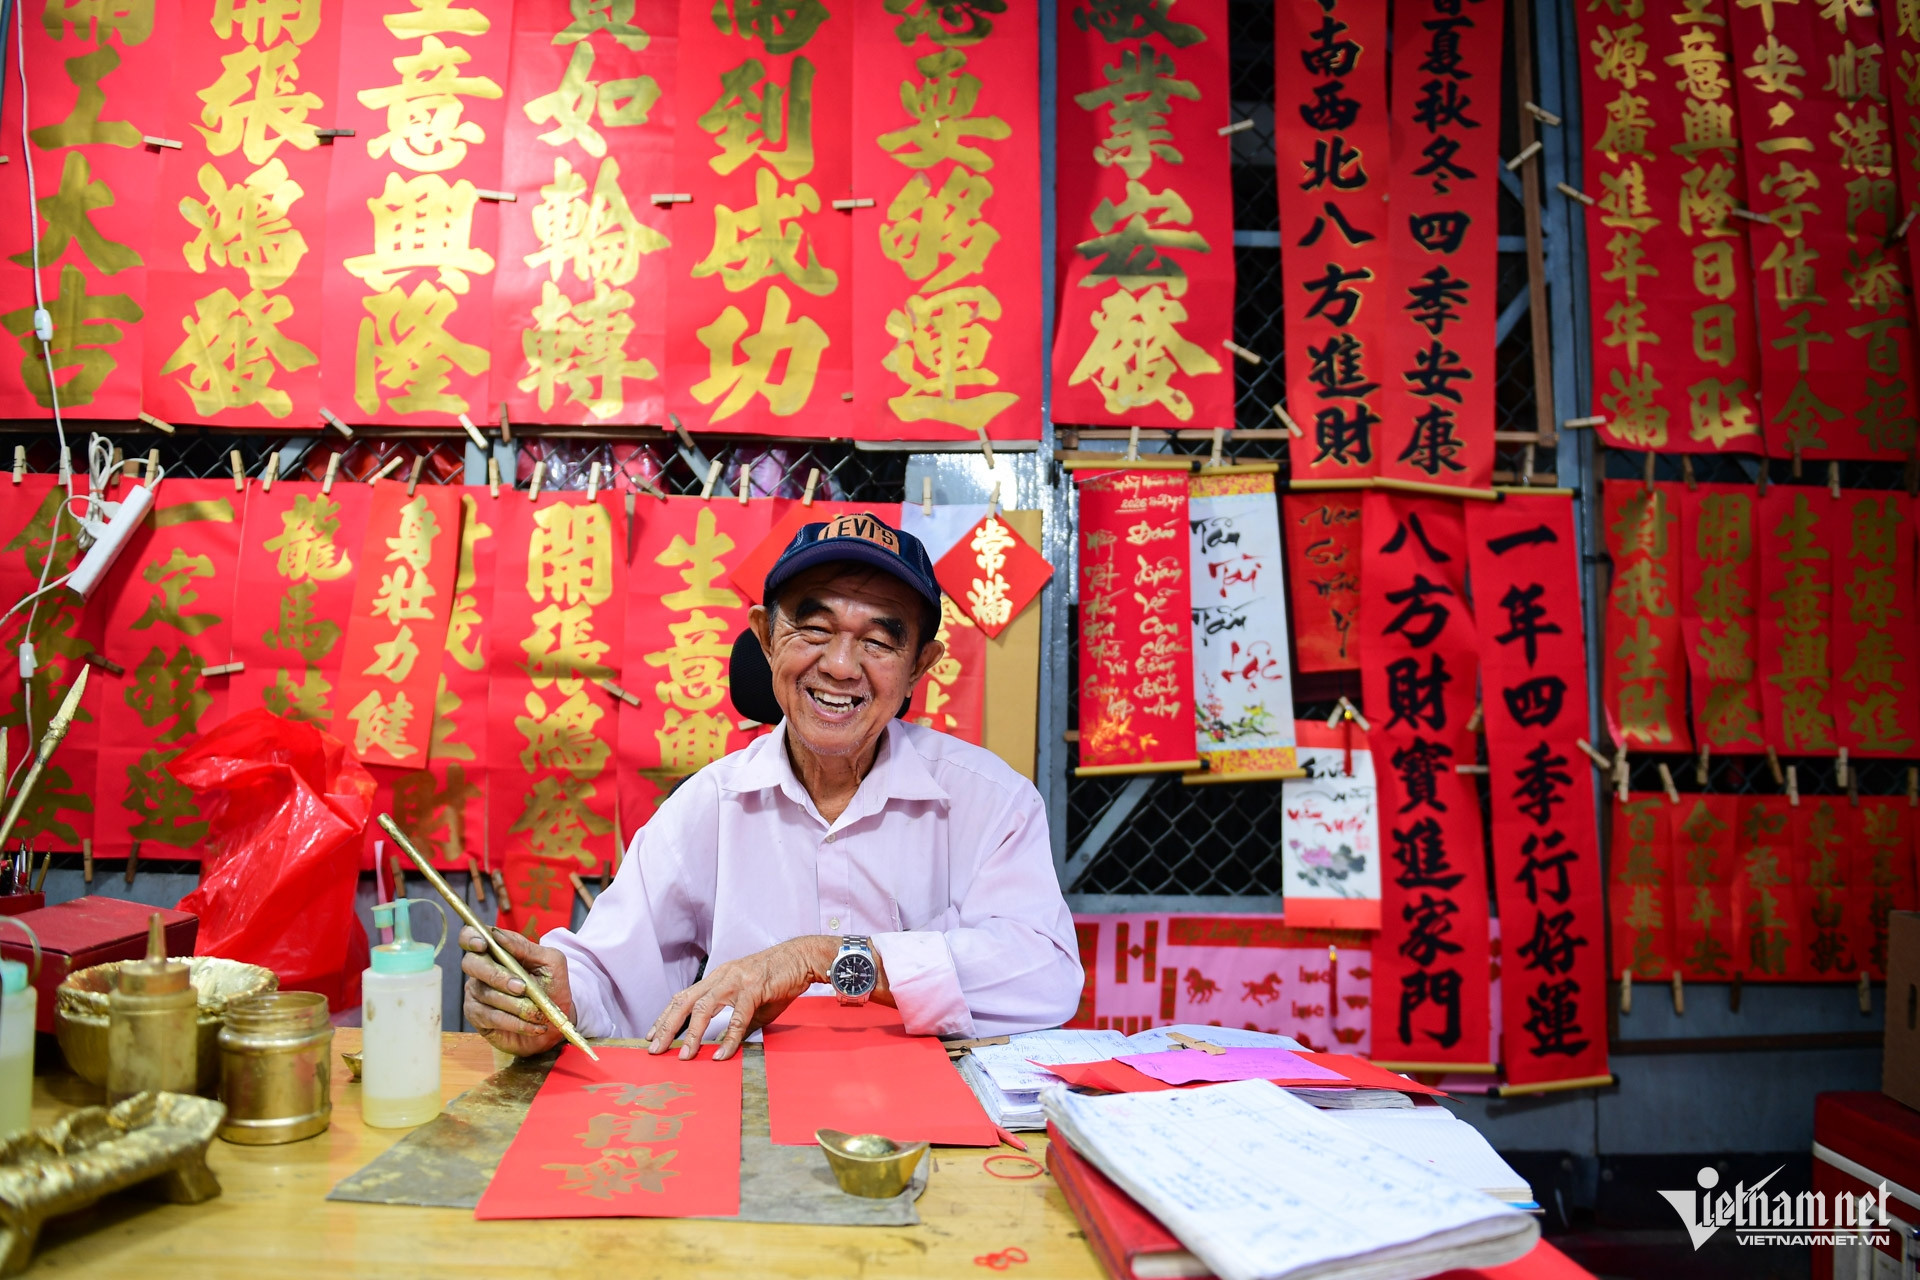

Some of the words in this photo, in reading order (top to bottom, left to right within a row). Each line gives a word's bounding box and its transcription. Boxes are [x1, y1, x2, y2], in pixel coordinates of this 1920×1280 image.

[1298, 0, 1382, 467] 南西北八方進財
[1398, 0, 1486, 475] 夏秋冬四季安康
[1588, 0, 1670, 448] 源廣進年年滿
[824, 518, 893, 546] LEVI'S
[1487, 524, 1590, 1059] 一年四季行好運
